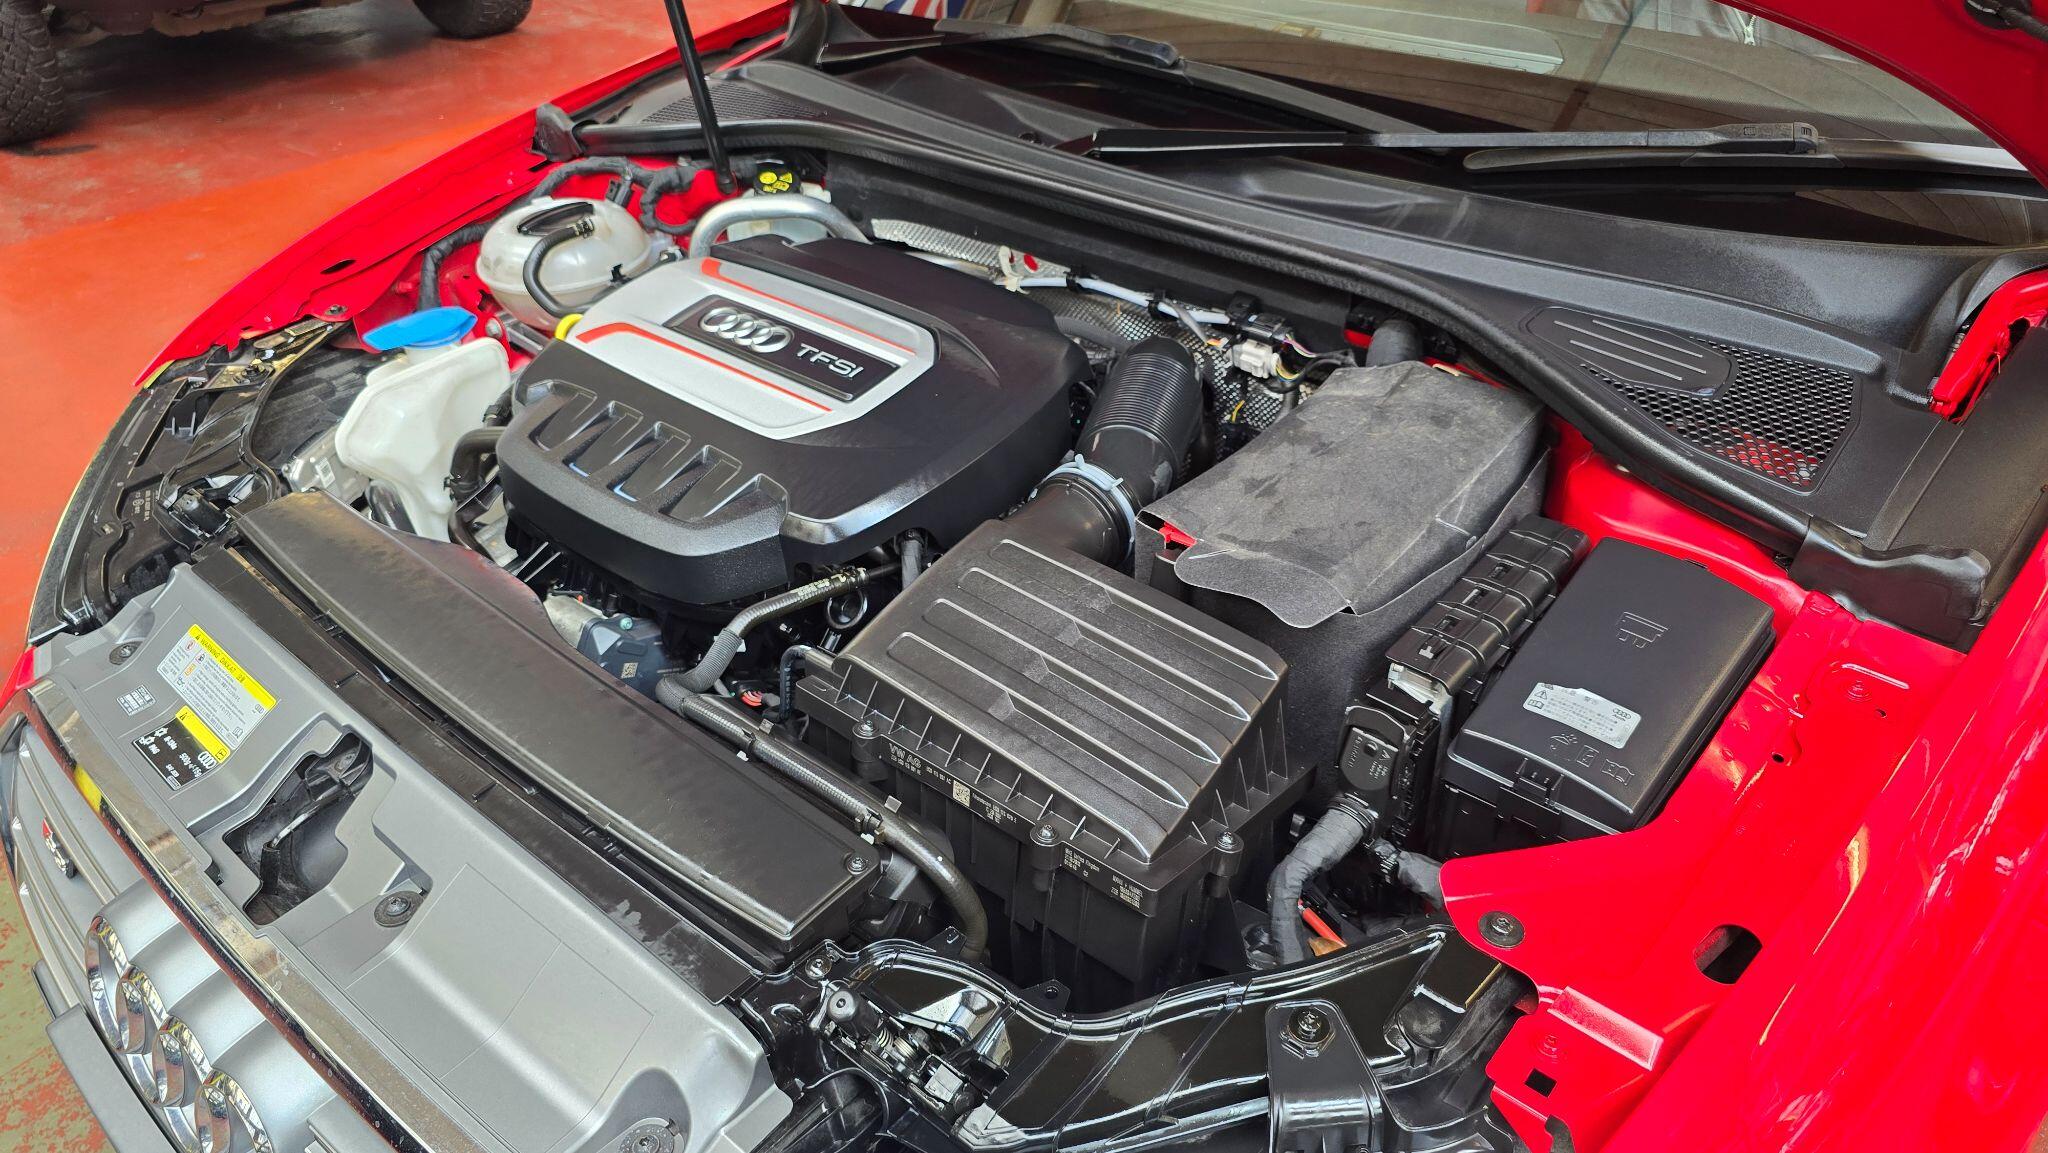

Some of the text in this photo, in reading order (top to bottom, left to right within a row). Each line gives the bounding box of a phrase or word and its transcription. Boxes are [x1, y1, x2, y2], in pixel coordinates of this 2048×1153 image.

[796, 343, 865, 378] TFSI
[201, 638, 220, 658] WARNING
[889, 743, 906, 758] VW
[907, 755, 922, 768] AG
